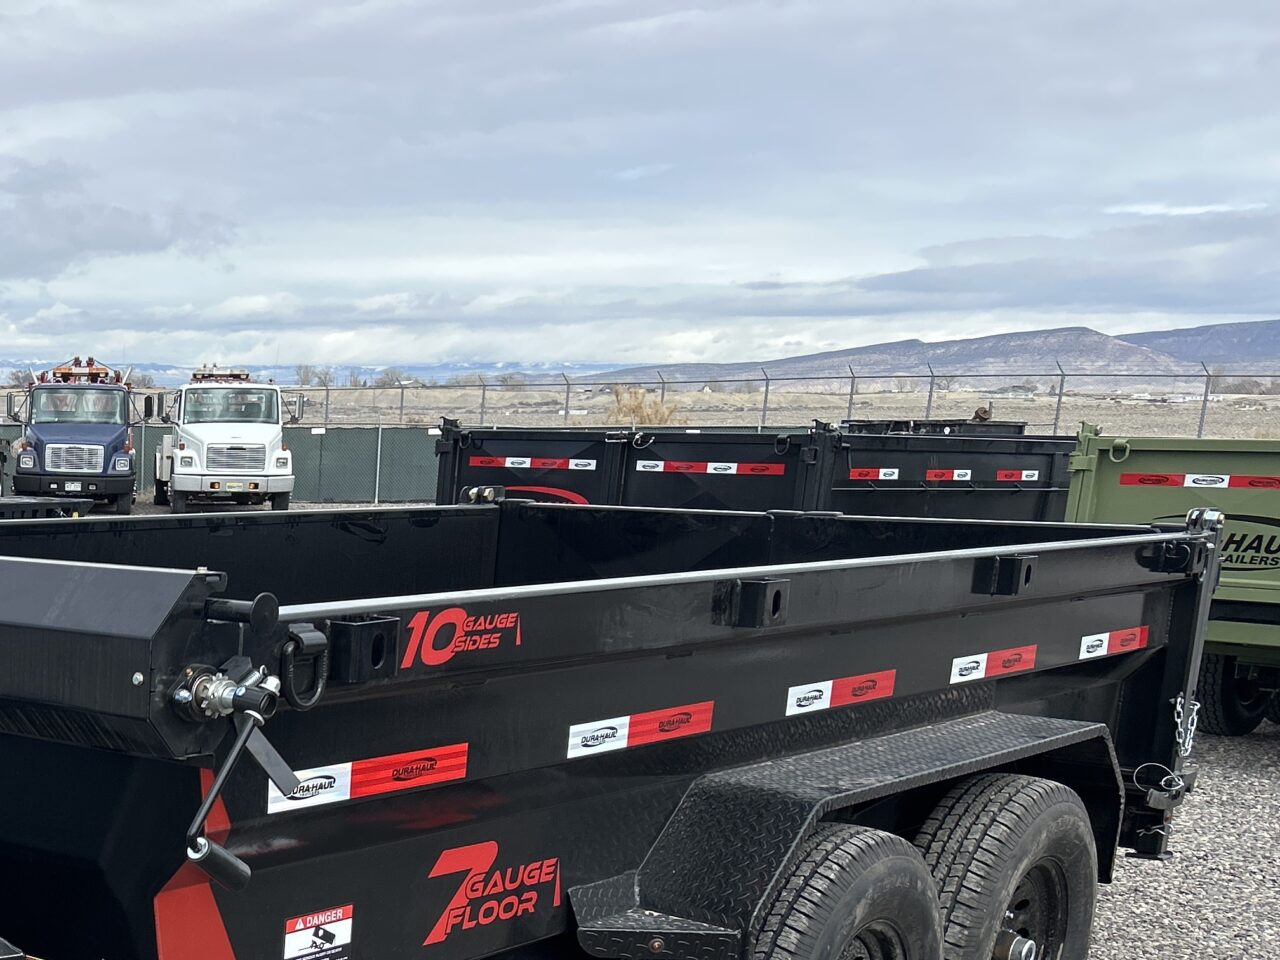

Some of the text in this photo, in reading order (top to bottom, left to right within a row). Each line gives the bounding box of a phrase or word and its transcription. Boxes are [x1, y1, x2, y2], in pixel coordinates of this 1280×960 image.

[1221, 554, 1280, 566] AILERS
[400, 607, 519, 669] 10 GAUGE
[453, 633, 502, 652] SIDES
[292, 780, 335, 796] URA-HAUL
[422, 840, 559, 946] 7 GAUGE
[306, 908, 343, 927] DANGER
[445, 891, 538, 934] FLOOR
